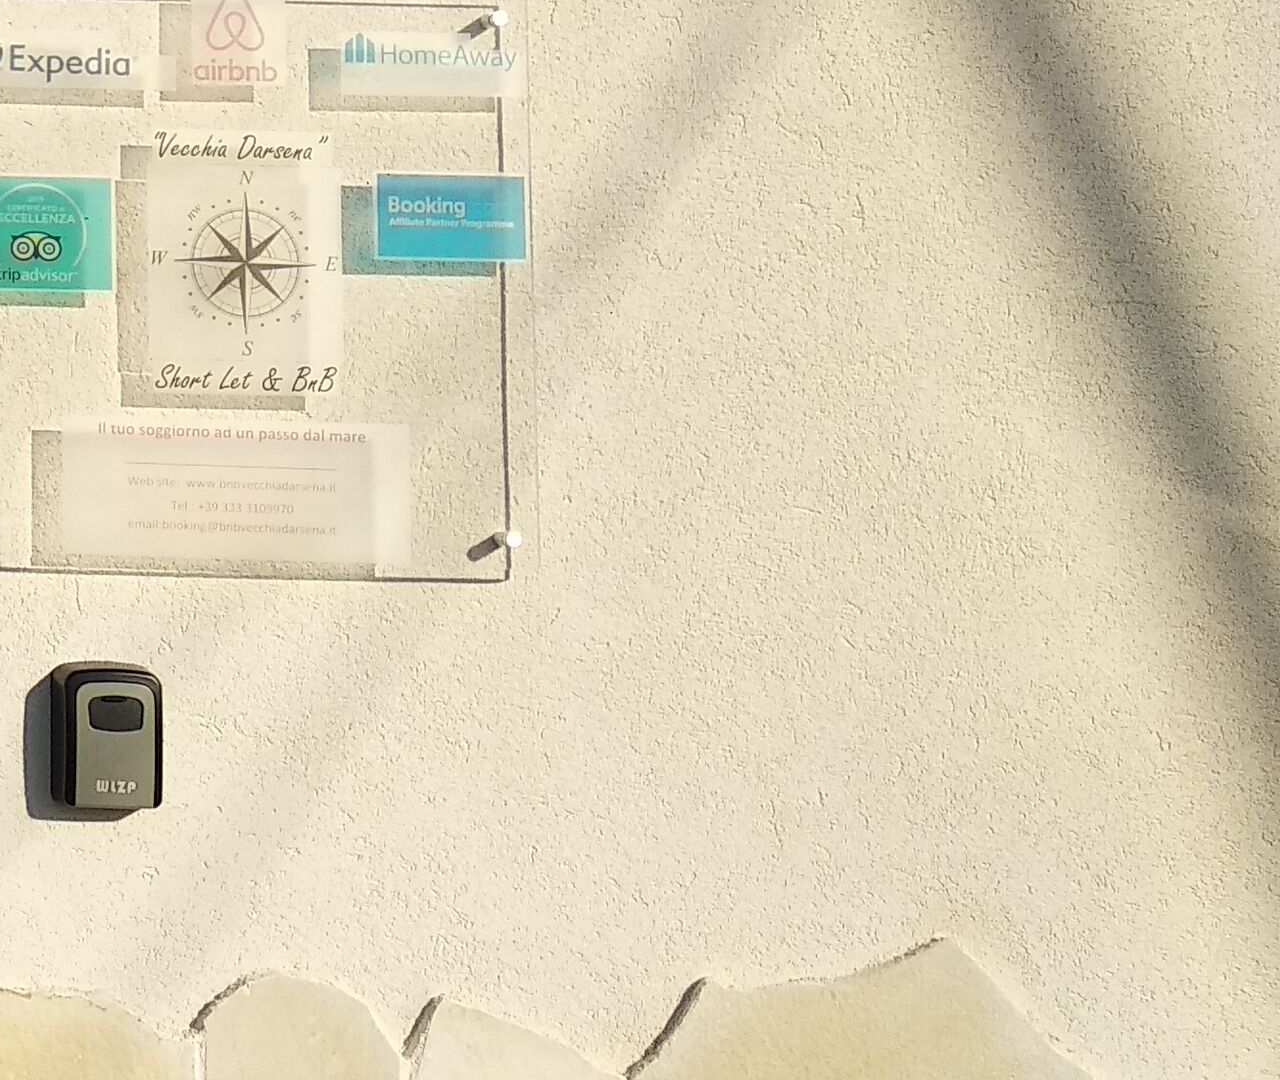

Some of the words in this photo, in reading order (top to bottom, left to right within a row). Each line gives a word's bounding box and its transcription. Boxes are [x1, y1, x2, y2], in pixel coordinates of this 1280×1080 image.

[10, 44, 131, 83] Expedia
[381, 43, 517, 72] HomeAway
[194, 59, 278, 83] airbnb
[240, 170, 254, 185] N
[388, 196, 466, 218] Booking
[389, 217, 425, 227] Affiliate
[426, 218, 459, 228] Partner
[151, 249, 169, 265] W
[326, 256, 338, 272] E
[241, 340, 254, 356] S
[155, 363, 213, 390] Short
[219, 366, 253, 390] Let
[262, 367, 283, 391] &
[292, 366, 338, 393] BnB
[98, 422, 106, 434] Il
[111, 424, 135, 435] tuo
[139, 424, 210, 439] soggiorno
[214, 427, 232, 439] ad
[236, 429, 254, 440] un
[258, 430, 299, 443] passo
[303, 429, 325, 442] dal
[329, 431, 367, 444] mare
[128, 476, 154, 487] Web
